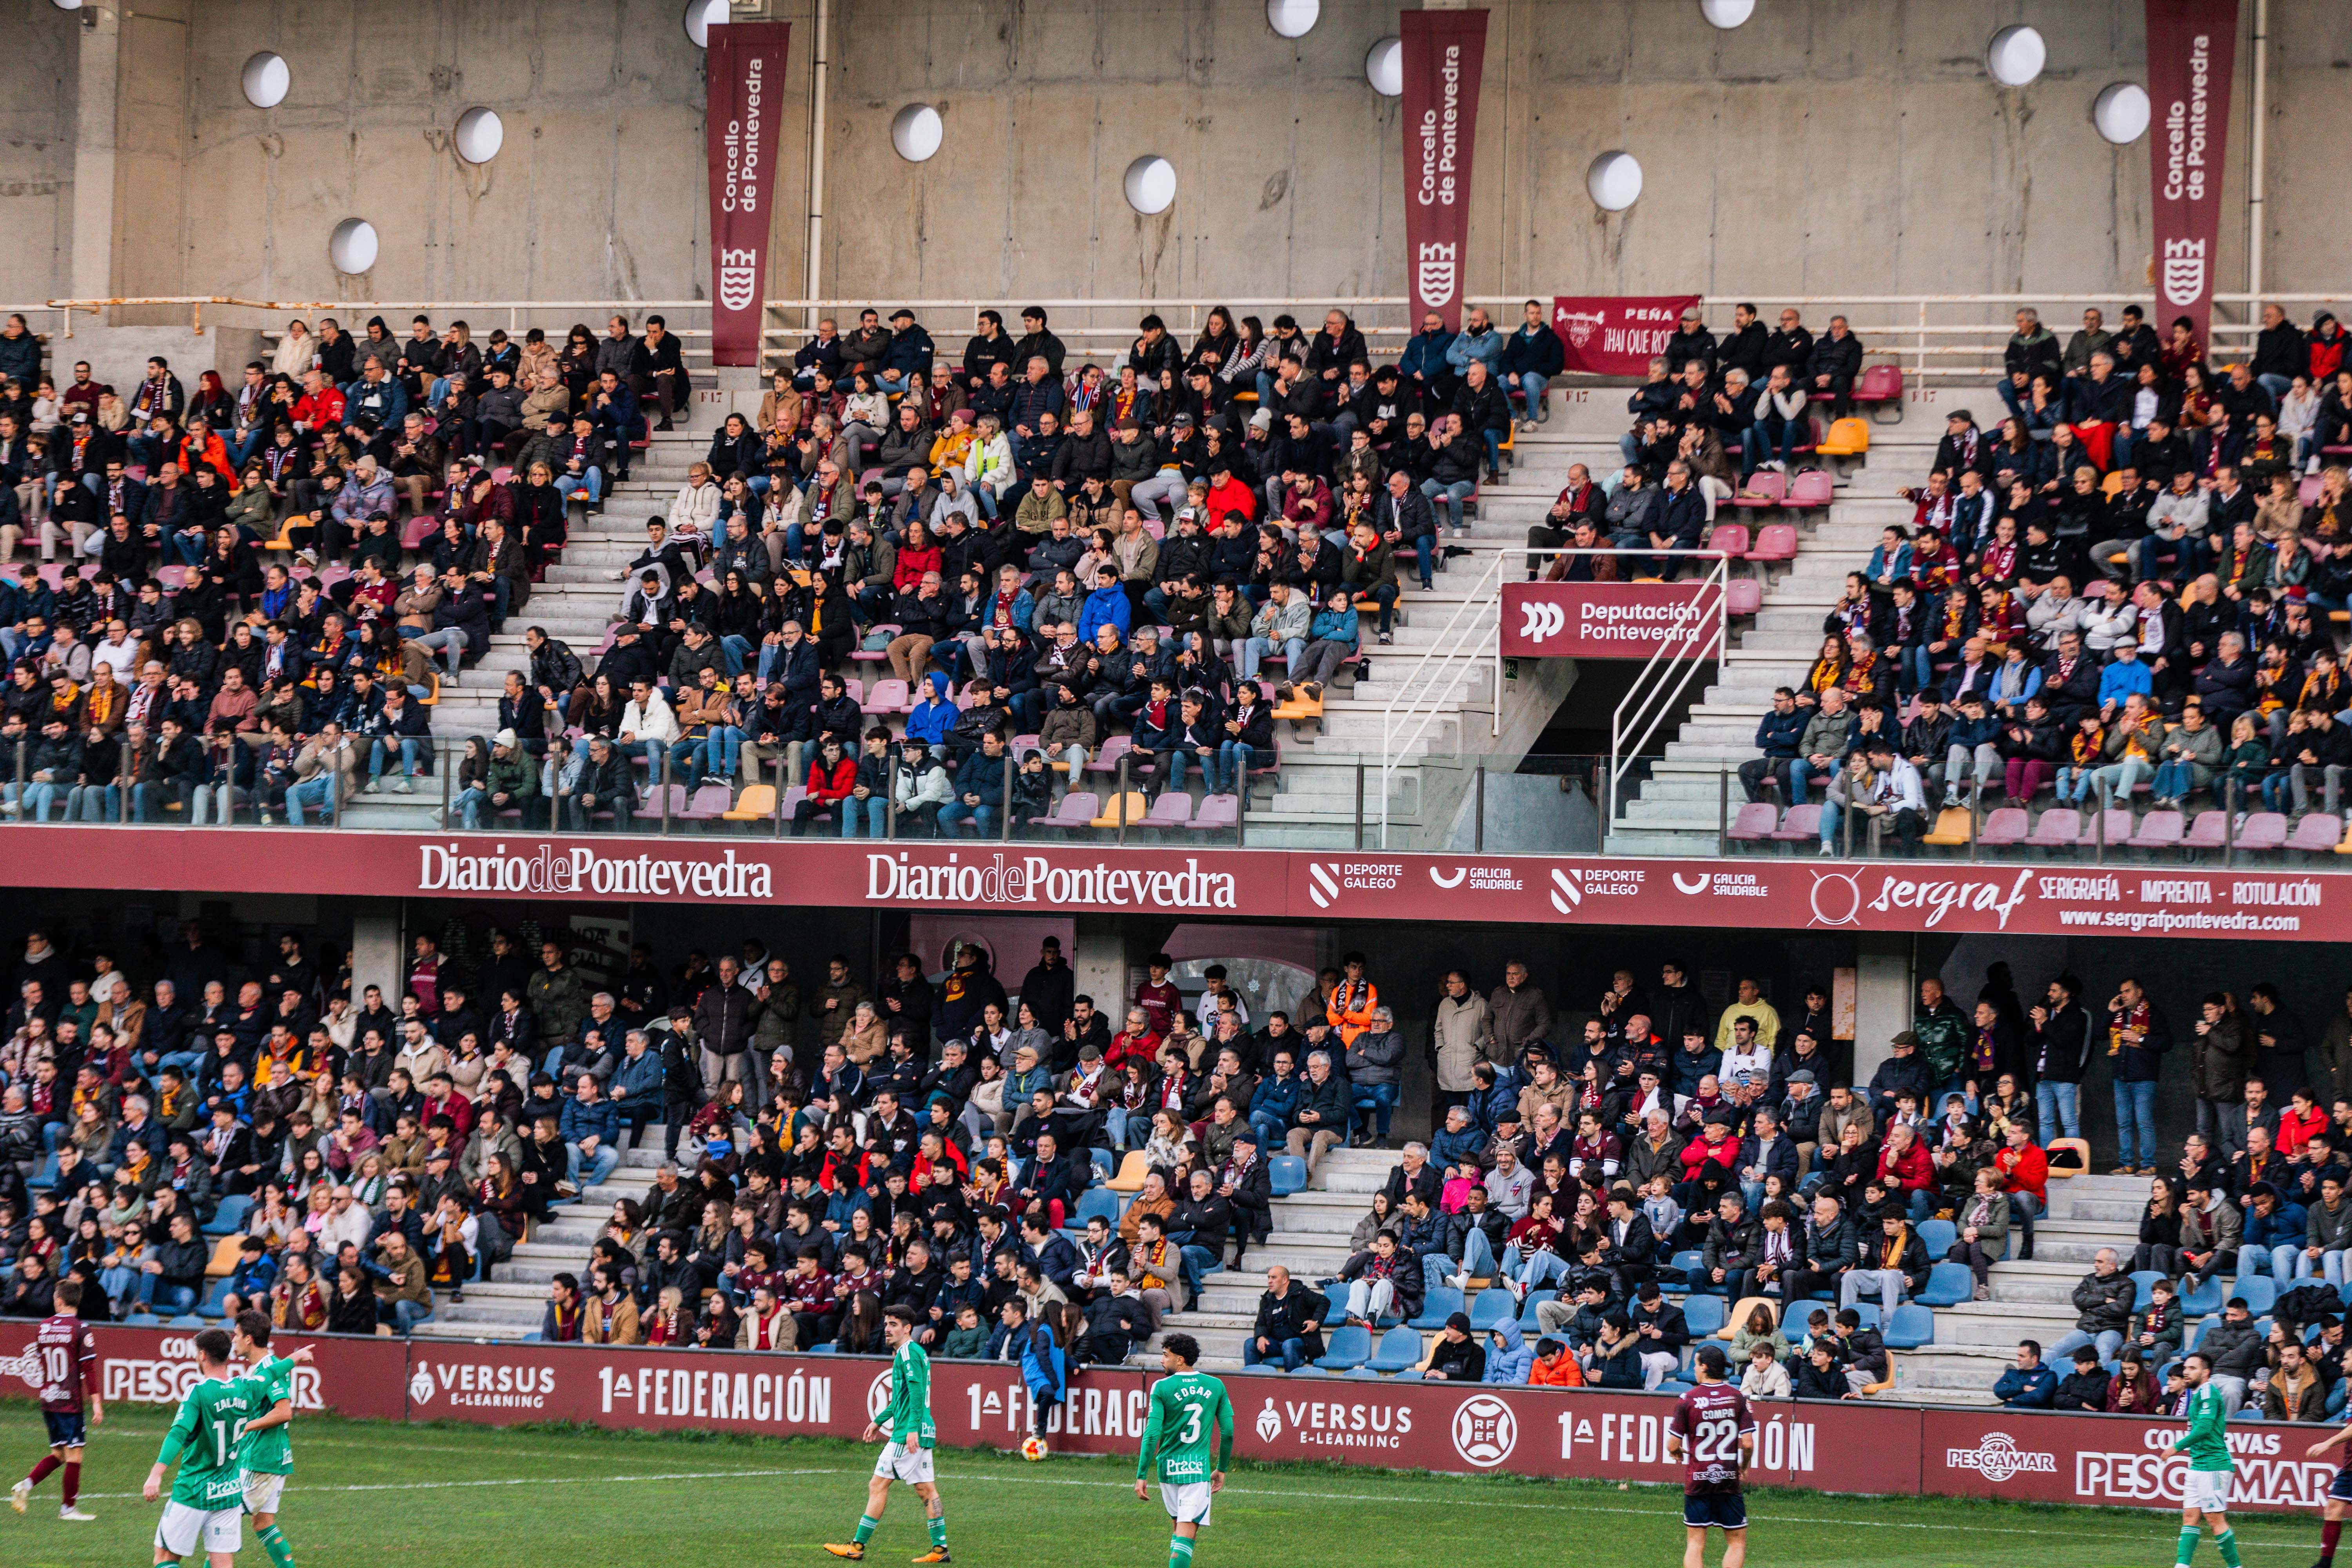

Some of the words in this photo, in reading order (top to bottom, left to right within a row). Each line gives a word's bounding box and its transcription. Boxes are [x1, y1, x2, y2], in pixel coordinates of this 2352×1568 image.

[1439, 45, 1460, 174] Pontevedra
[2187, 34, 2210, 167] Pontevedra
[741, 58, 763, 181] Pontevedra
[1418, 109, 1437, 205] Concello
[2164, 101, 2185, 201] Concello
[722, 120, 740, 212] Concello
[740, 186, 756, 212] de
[1438, 178, 1455, 205] de
[2186, 173, 2205, 201] de
[1625, 308, 1674, 321] PEÑA
[1627, 328, 1650, 356] QUE
[1581, 601, 1700, 624] Deputación
[1581, 623, 1700, 642] Pontevedra
[1343, 877, 1397, 889] GALEGO
[1344, 864, 1403, 877] DEPORTE
[1469, 867, 1512, 879] GALICIA
[1584, 870, 1645, 883] DEPORTE
[1713, 873, 1757, 885] GALICIA
[1469, 879, 1523, 891] SAUDABLE
[1584, 882, 1639, 895] GALEGO
[1713, 884, 1769, 897] SAUDABLE
[2038, 873, 2118, 901] SERIGRAFÍA
[2140, 879, 2213, 904] IMPRENTA
[2232, 877, 2322, 906] ROTULACIÓN
[1867, 867, 2034, 931] sergraf
[2060, 908, 2300, 932] www.sergrafpontevedra.com
[42, 1346, 69, 1383] 10
[437, 1363, 555, 1395] VERSUS
[450, 1392, 544, 1409] E-LEARNING
[637, 1367, 831, 1424] FEDERACIÓN
[1174, 1385, 1212, 1402] EDGAR
[1180, 1403, 1203, 1444] 3
[1285, 1400, 1412, 1433] VERSUS
[1702, 1408, 1735, 1420] COMPA
[1299, 1430, 1400, 1449] E-LEARNING
[1695, 1419, 1738, 1461] 22
[2144, 1428, 2281, 1455] CONRVAS
[1166, 1459, 1203, 1473] Prace
[1946, 1448, 2058, 1472] PESCAMAR
[2076, 1451, 2340, 1507] PESCMAR
